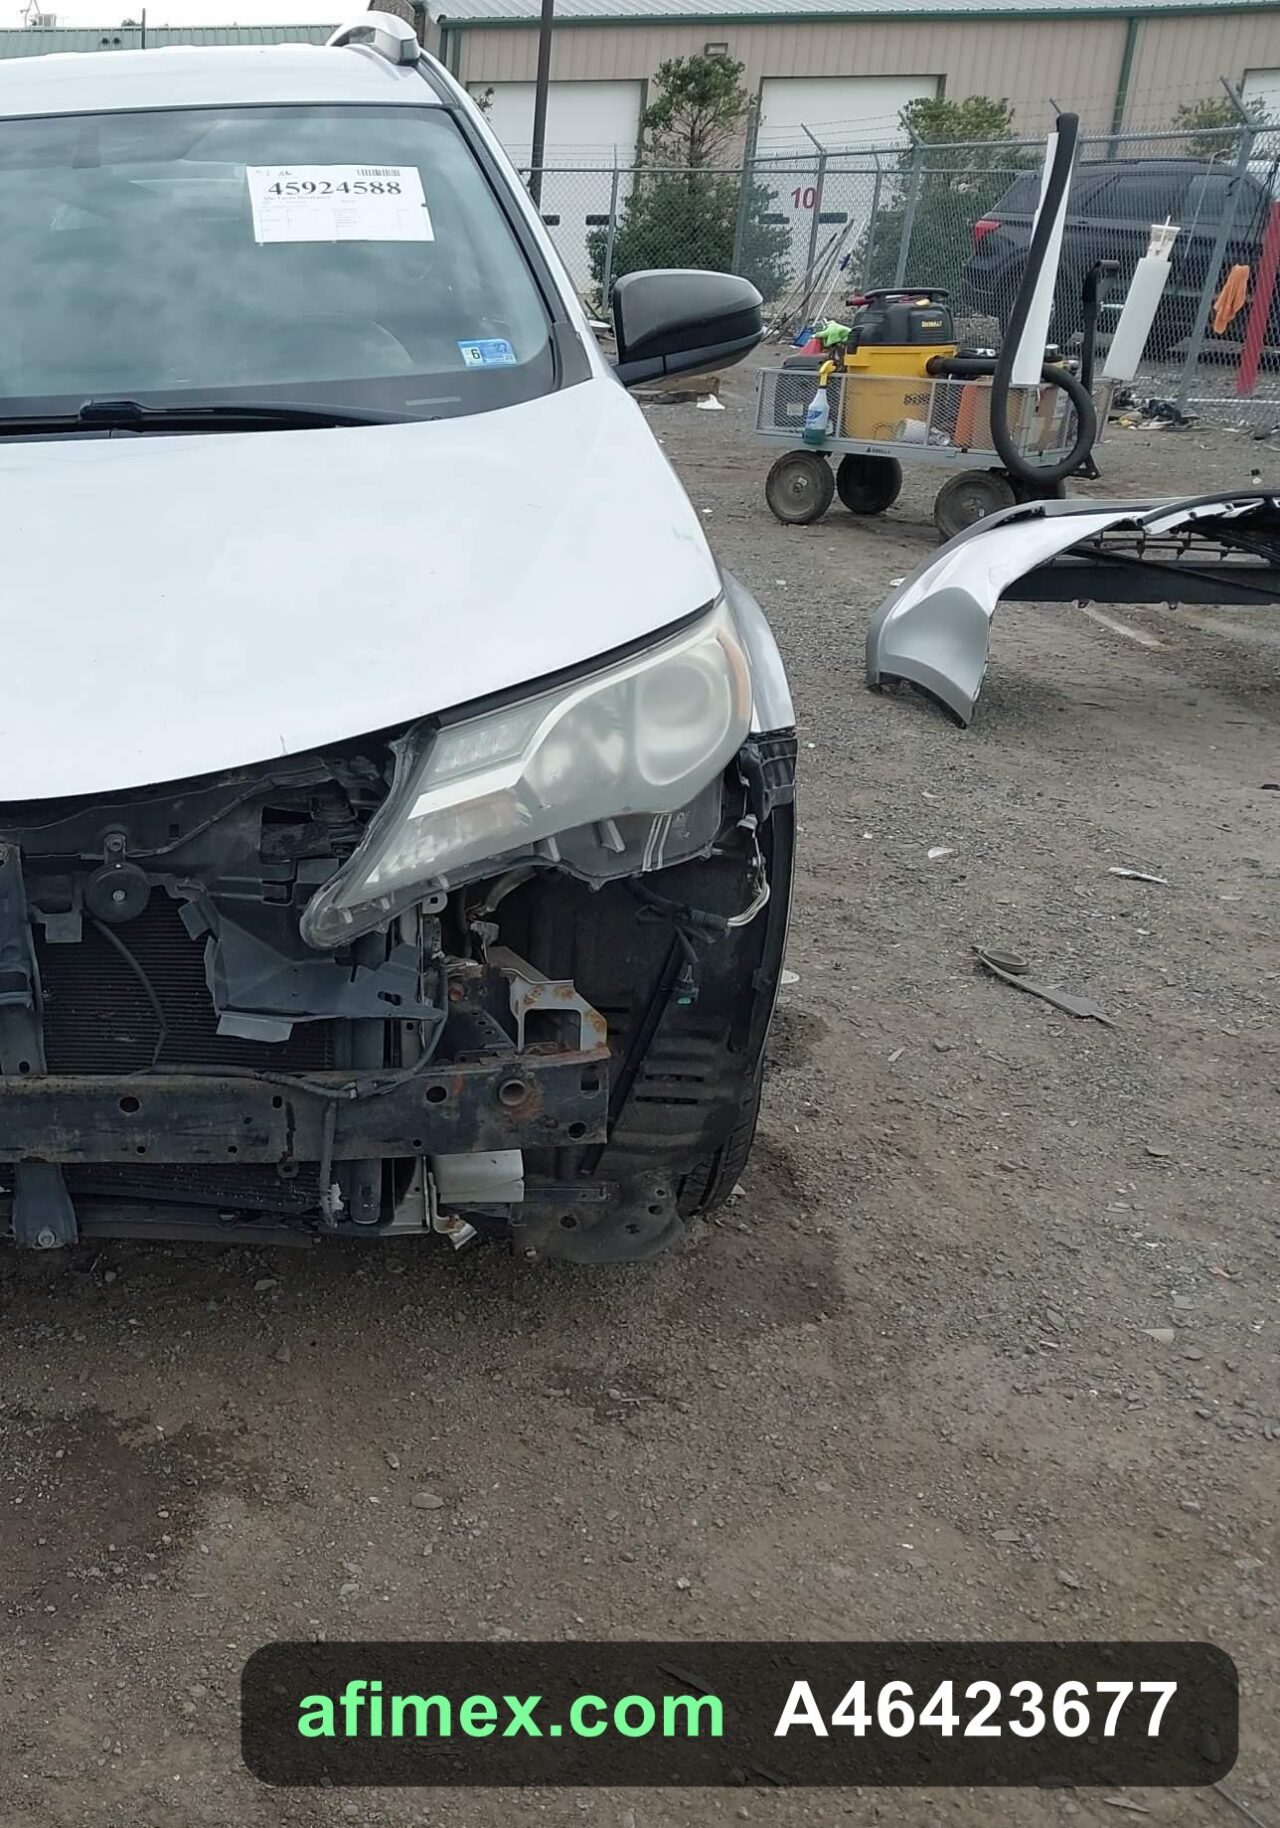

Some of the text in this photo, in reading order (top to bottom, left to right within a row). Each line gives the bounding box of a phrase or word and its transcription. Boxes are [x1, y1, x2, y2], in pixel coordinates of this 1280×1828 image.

[268, 181, 402, 195] 45924588
[791, 187, 817, 209] 10
[471, 348, 480, 359] 6
